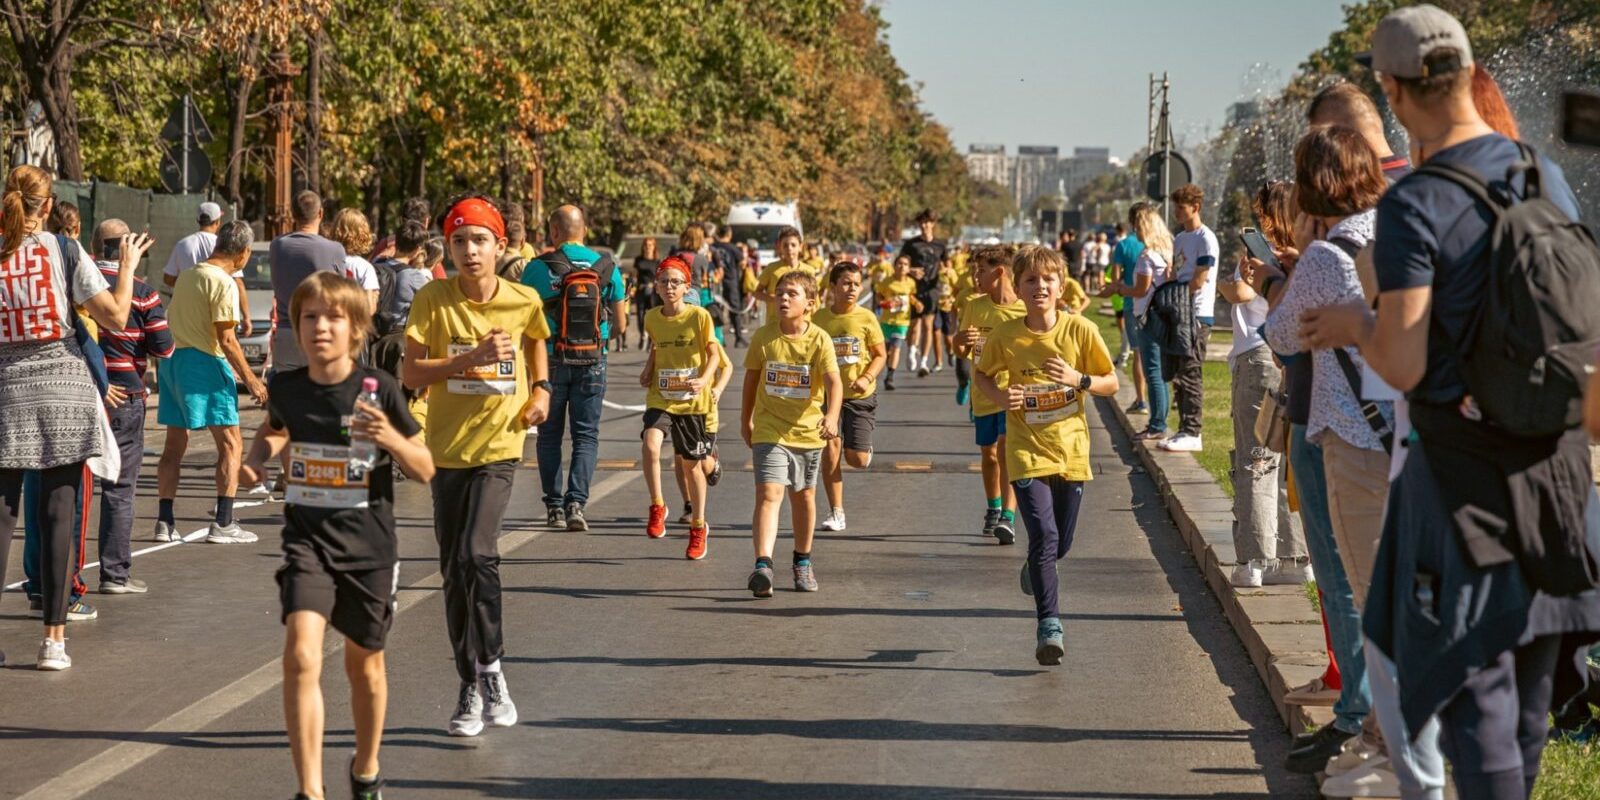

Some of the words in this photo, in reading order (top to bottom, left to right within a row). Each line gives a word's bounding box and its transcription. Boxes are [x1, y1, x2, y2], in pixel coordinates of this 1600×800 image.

[0, 274, 48, 310] ANG
[0, 307, 53, 342] ELES
[308, 465, 340, 479] 22481
